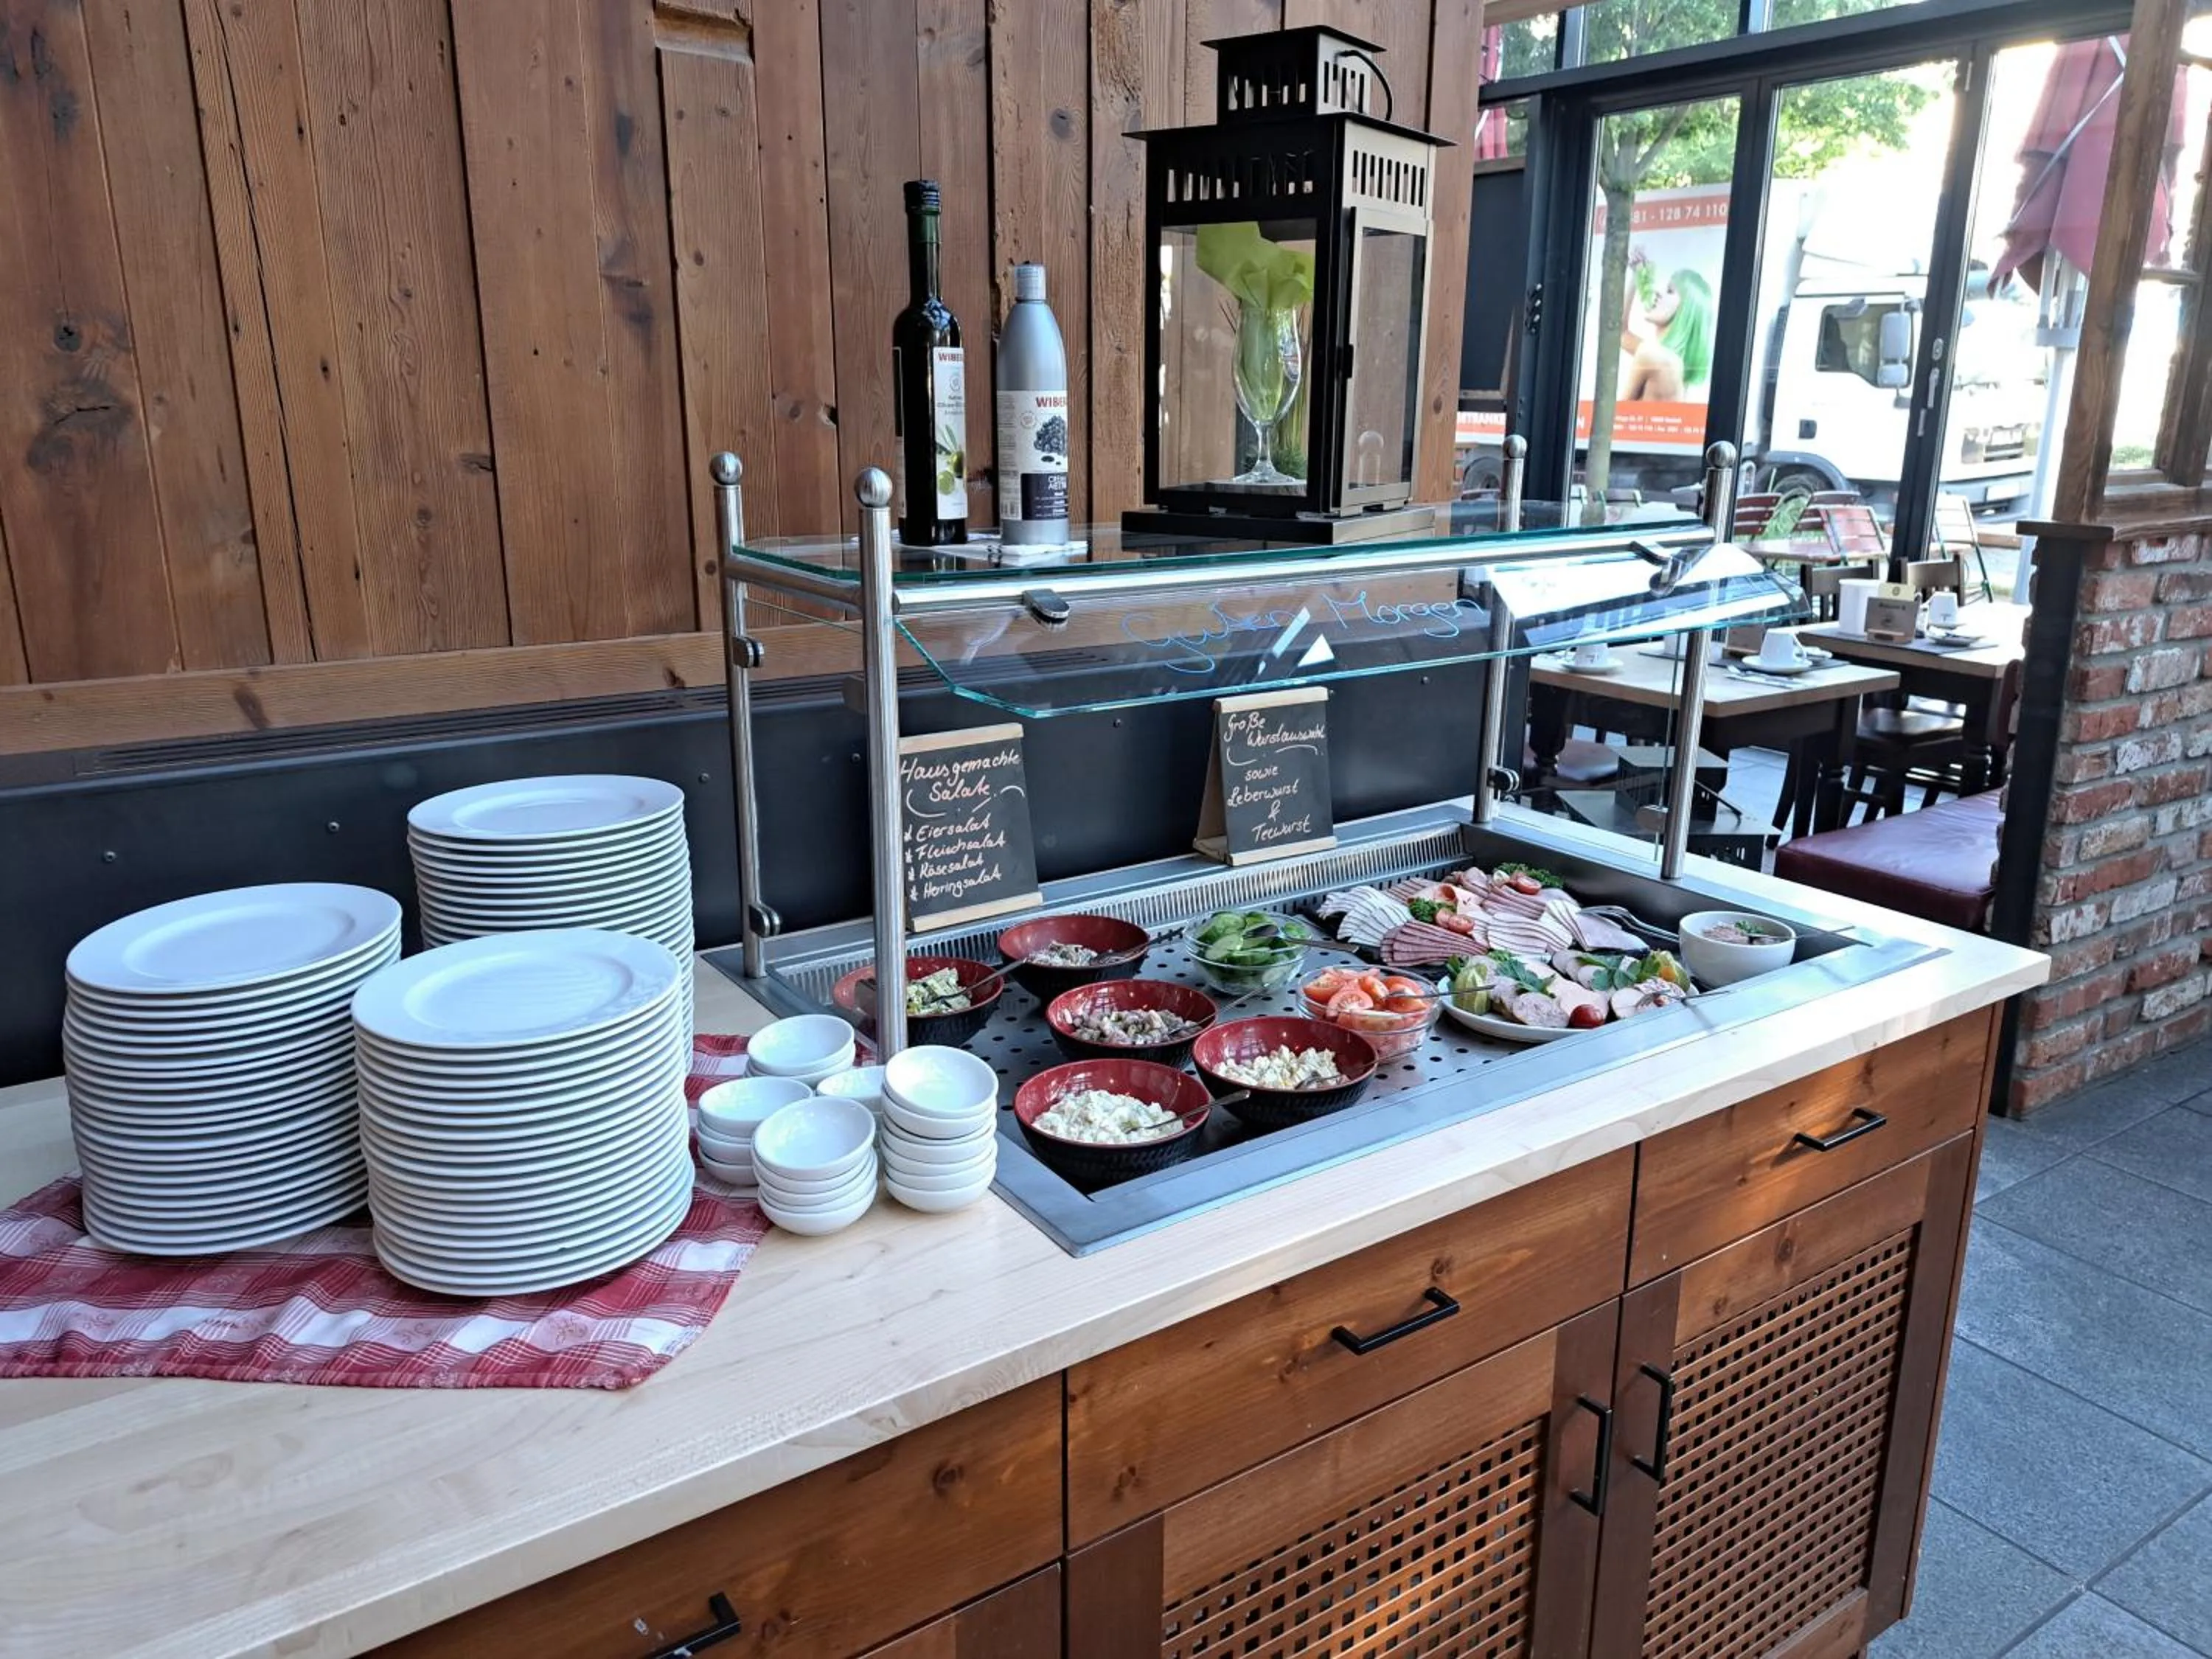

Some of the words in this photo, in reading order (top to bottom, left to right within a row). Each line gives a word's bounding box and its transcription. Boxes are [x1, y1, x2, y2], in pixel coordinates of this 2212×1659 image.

[1660, 206, 1682, 221] 128
[1686, 206, 1700, 219] 74
[1706, 203, 1728, 218] 110
[1321, 590, 1484, 639] Morgen
[900, 747, 1020, 787] Hausgemachte
[1245, 765, 1279, 782] sowie
[929, 775, 990, 803] Salate
[1227, 778, 1300, 808] Leberwurst
[1267, 799, 1281, 822] &
[916, 813, 991, 843] Eiersalat
[1251, 813, 1312, 844] Teewurst
[915, 830, 1006, 861] Fleischsalat
